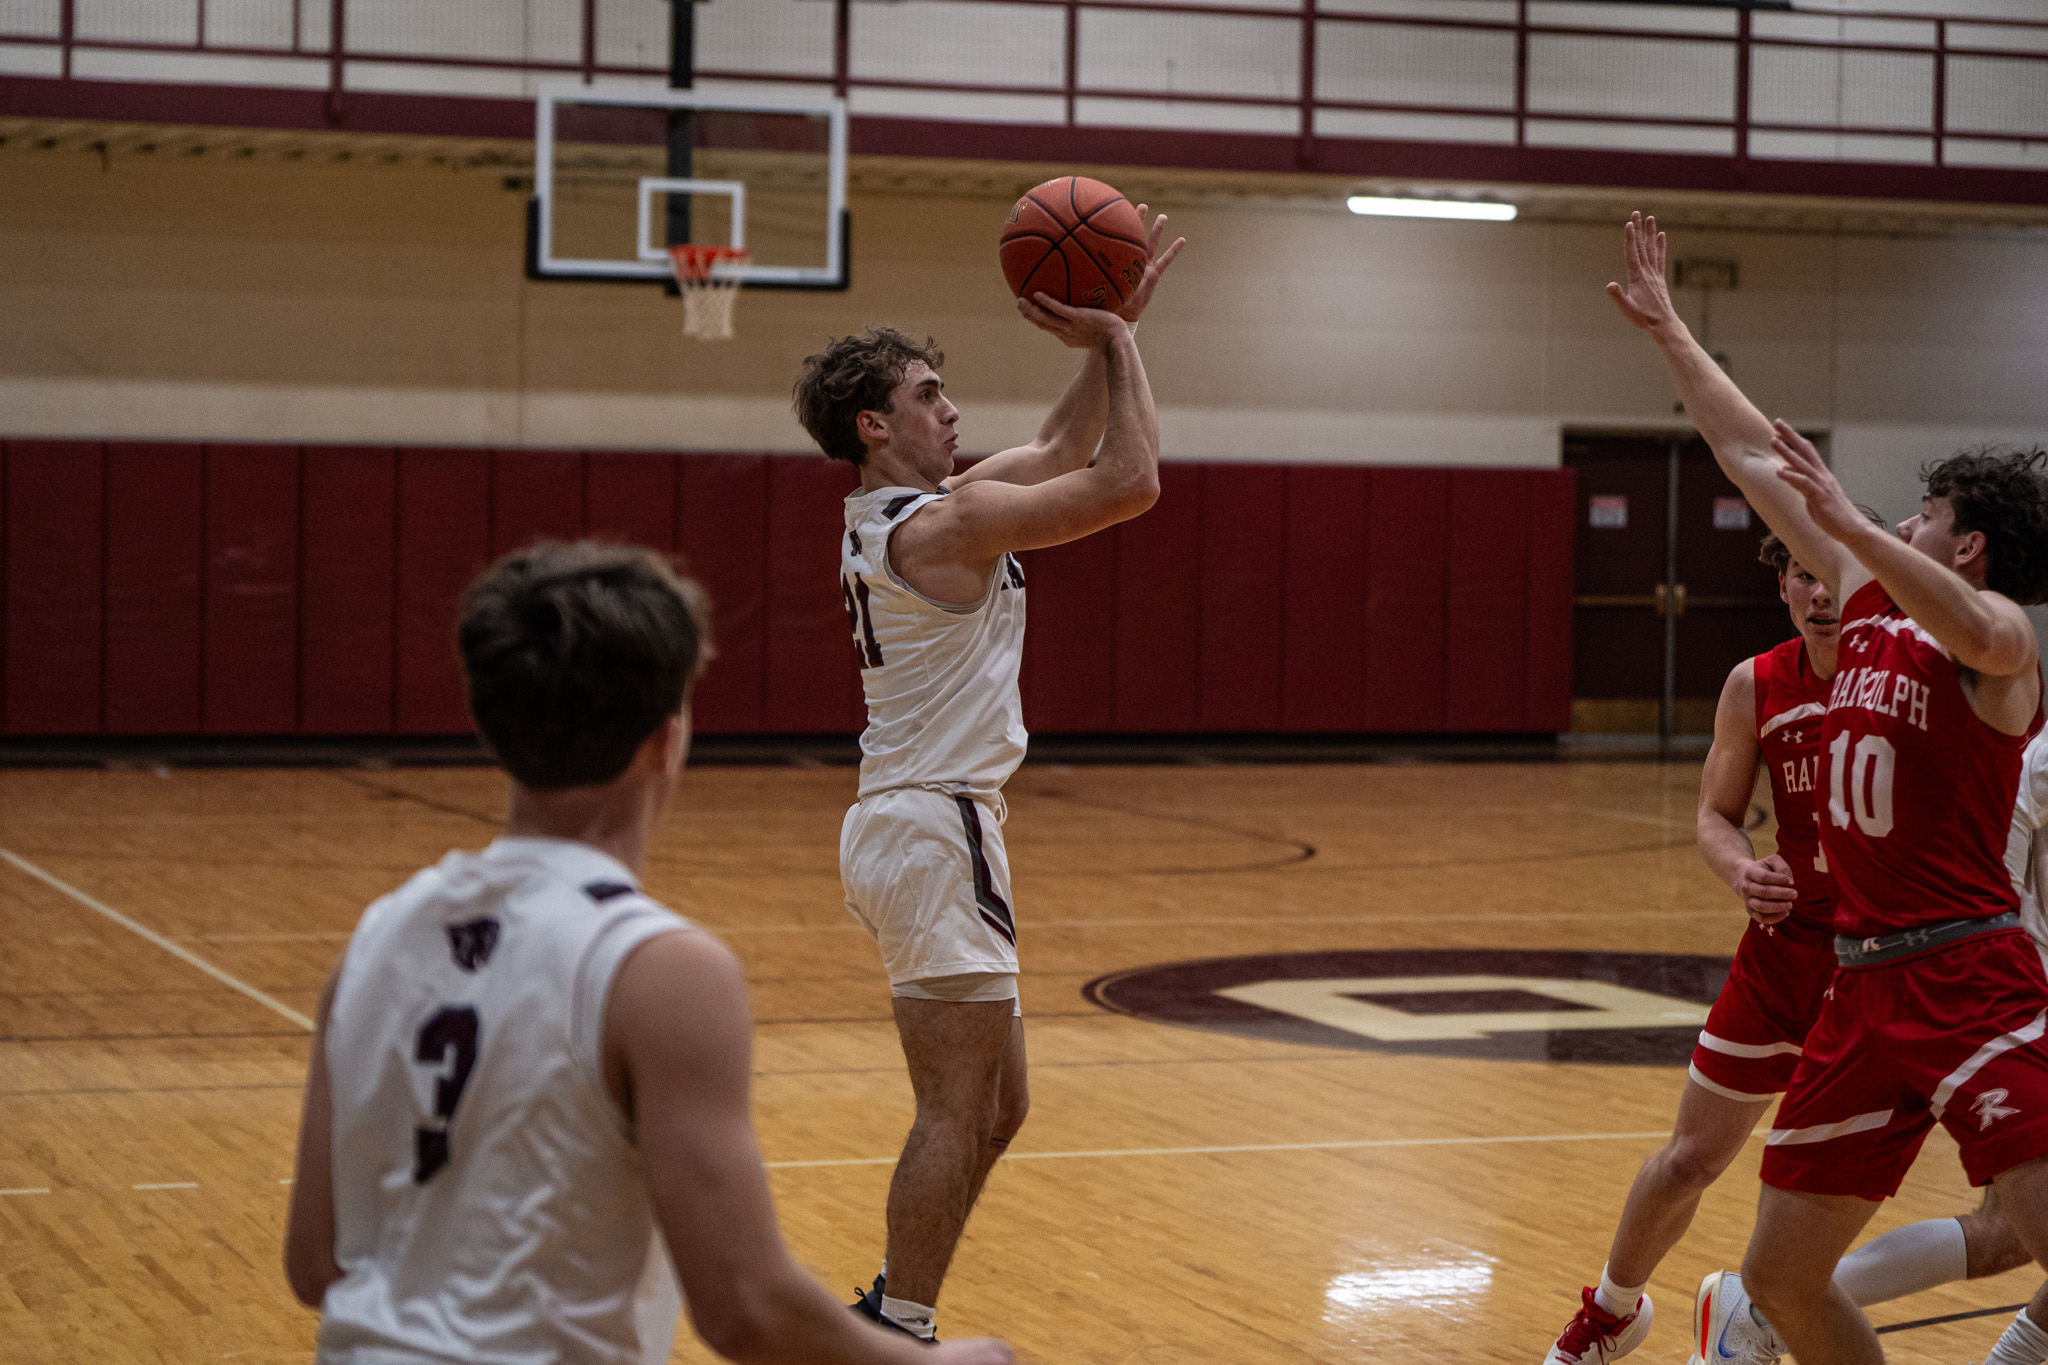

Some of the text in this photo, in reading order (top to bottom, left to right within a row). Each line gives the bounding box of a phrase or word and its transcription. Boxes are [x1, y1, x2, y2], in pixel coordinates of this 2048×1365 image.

[1826, 666, 1931, 732] RANDOLPH
[1828, 729, 1897, 838] 10
[414, 1005, 480, 1185] 3
